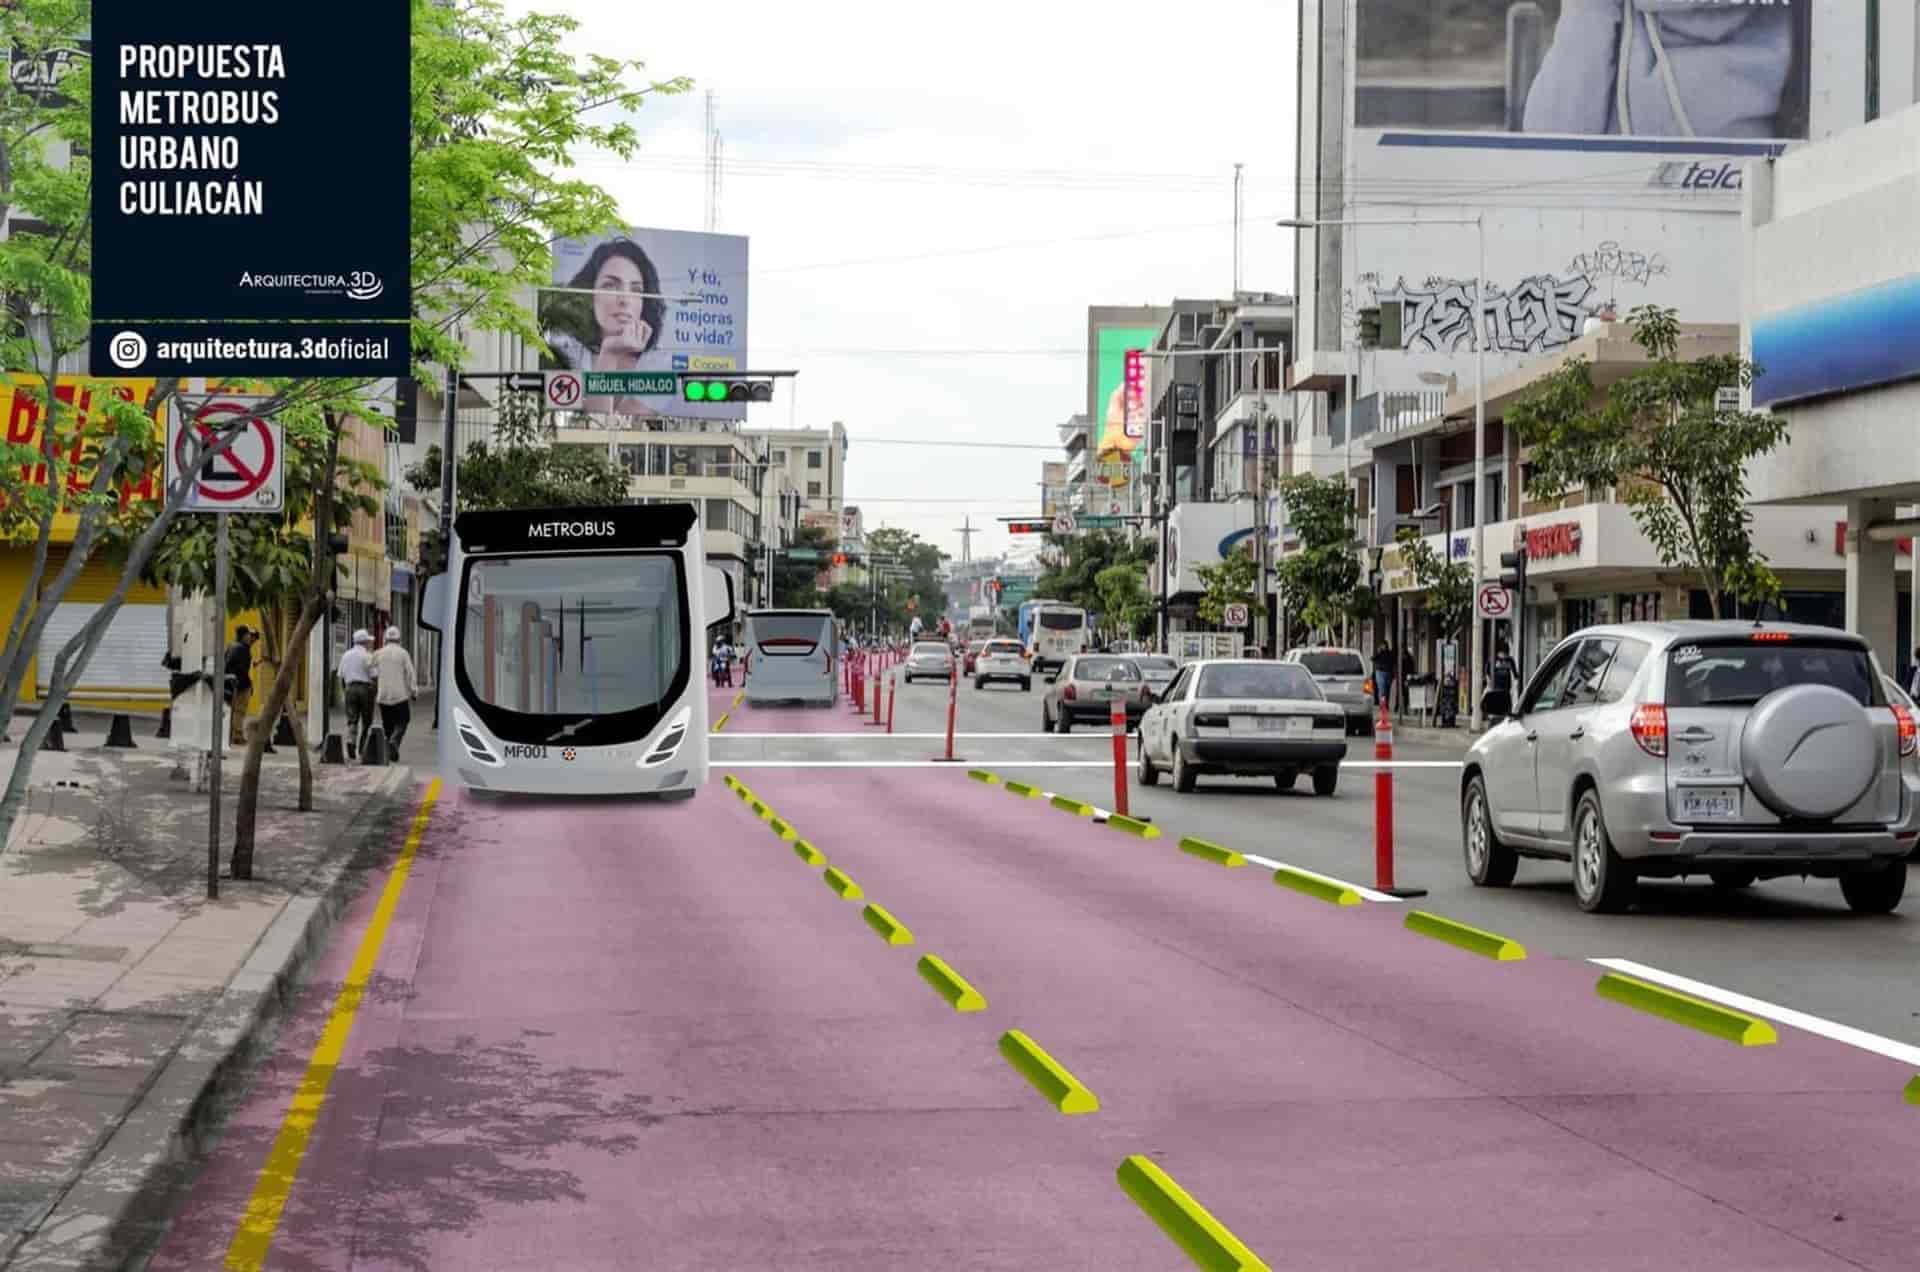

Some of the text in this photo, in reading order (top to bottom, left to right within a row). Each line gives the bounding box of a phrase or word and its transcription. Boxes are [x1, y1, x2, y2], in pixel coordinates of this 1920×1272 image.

[676, 308, 733, 326] mejoras
[675, 328, 734, 345] tu vida?
[588, 377, 673, 393] MIGUEL HIDALGO
[528, 521, 615, 537] METROBUS
[504, 746, 548, 759] MF001
